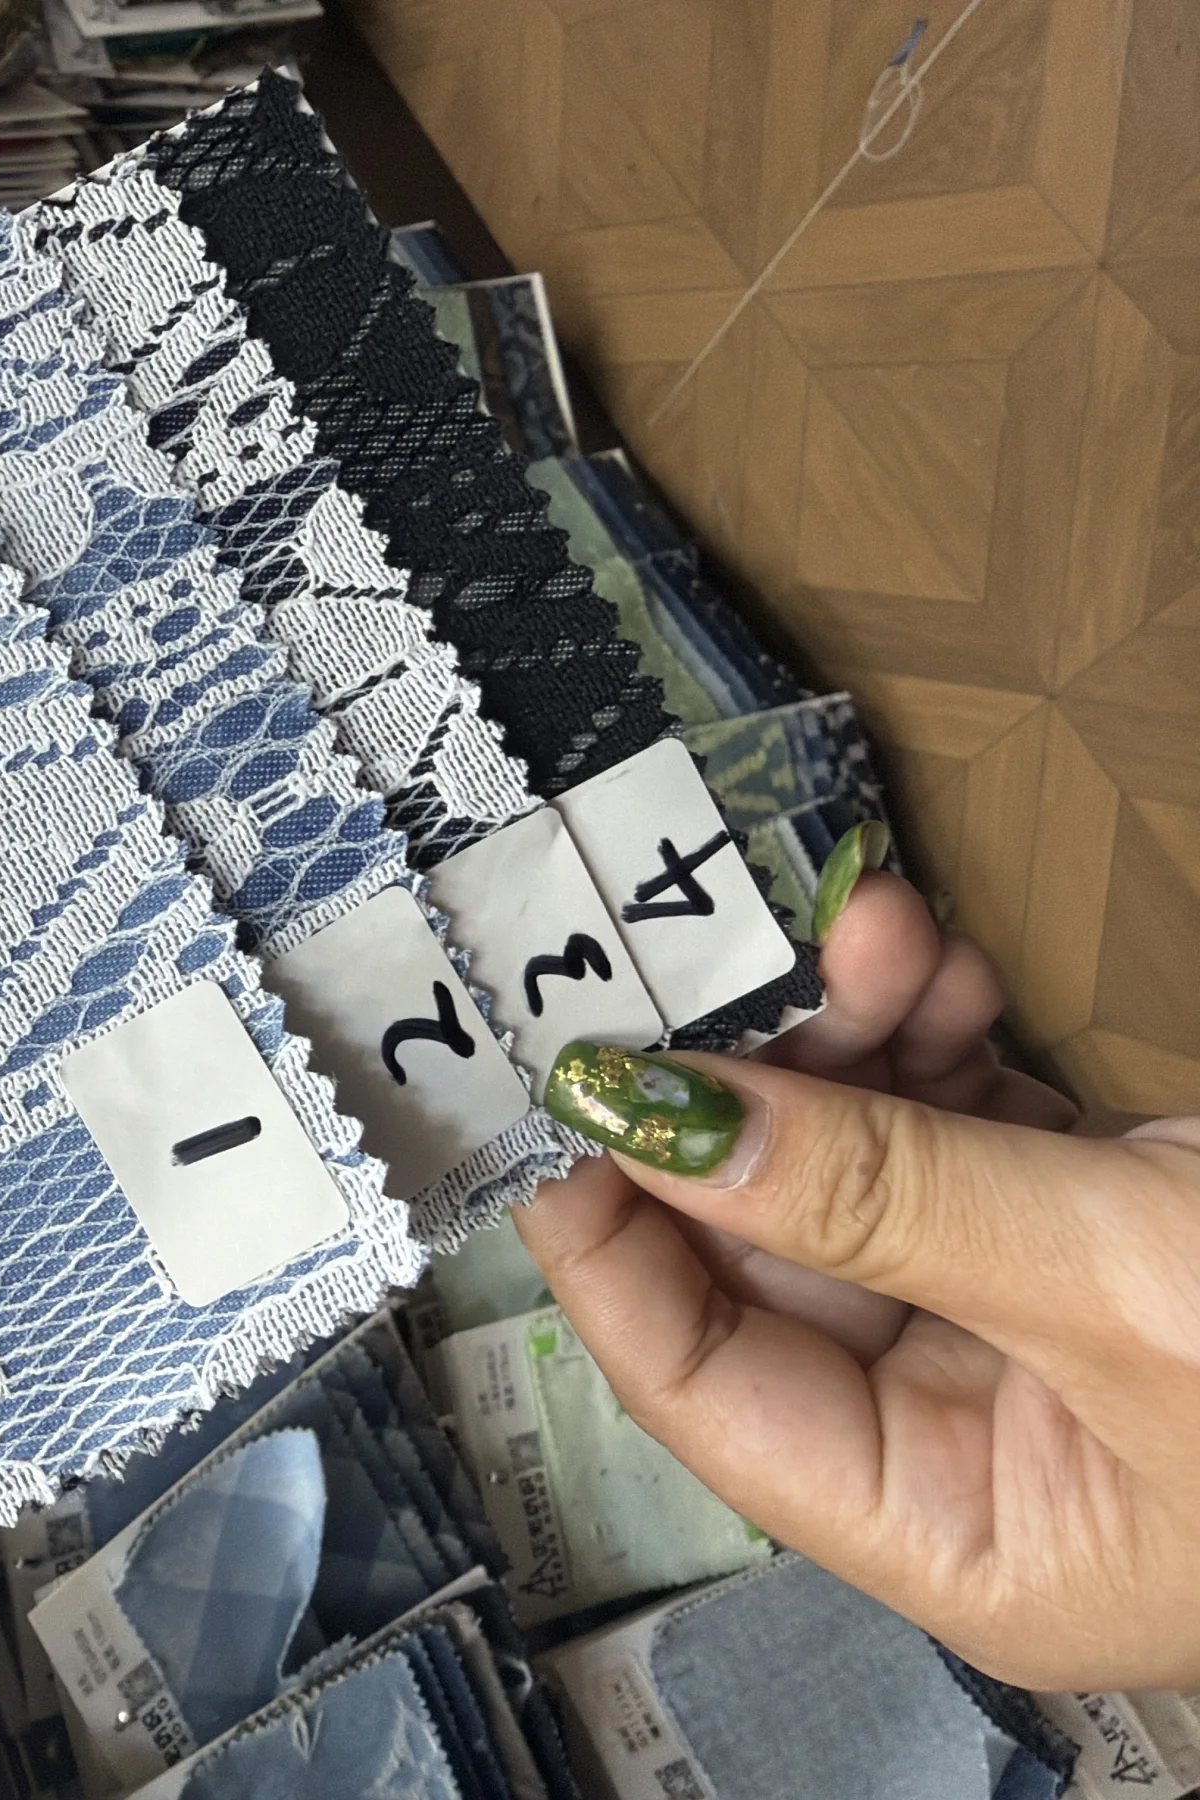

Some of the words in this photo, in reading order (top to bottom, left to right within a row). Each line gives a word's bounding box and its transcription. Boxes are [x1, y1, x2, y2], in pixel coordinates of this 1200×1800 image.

[621, 830, 732, 923] 4
[523, 933, 612, 1017] 3
[381, 981, 475, 1086] 2
[171, 1116, 261, 1166] 1
